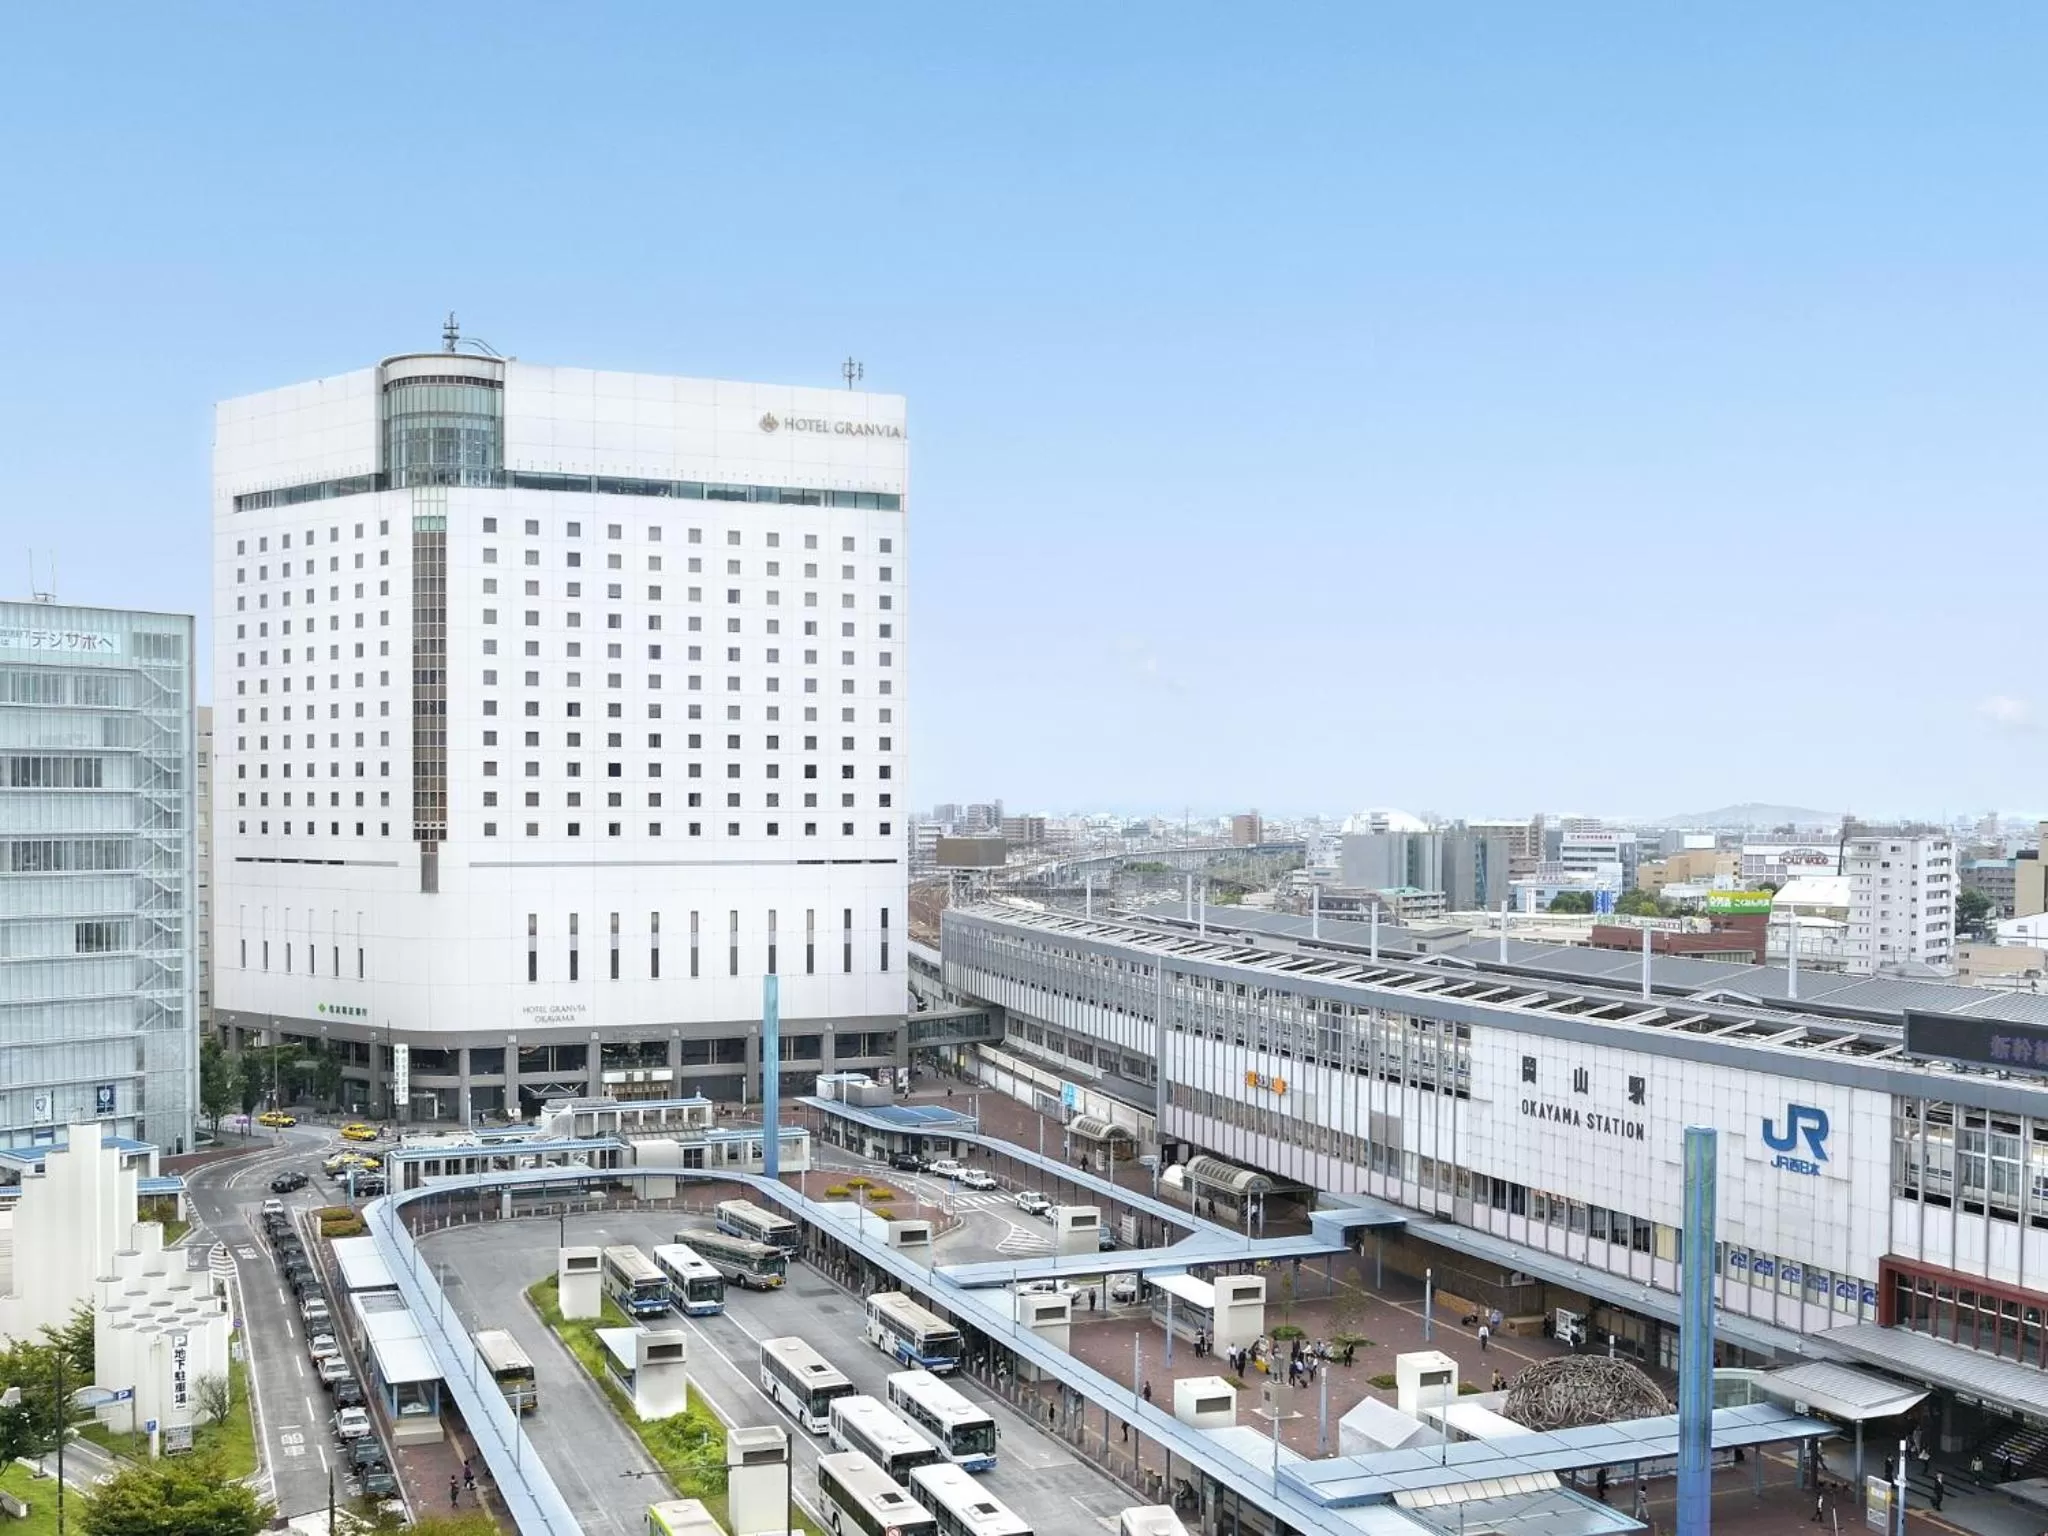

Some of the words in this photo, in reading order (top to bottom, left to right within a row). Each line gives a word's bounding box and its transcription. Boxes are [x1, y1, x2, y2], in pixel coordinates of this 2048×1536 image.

[784, 416, 830, 433] HOTEL
[834, 421, 901, 438] GRANVIA
[522, 1006, 547, 1014] HOTEL
[1521, 1098, 1581, 1128] OKAYAMA
[1587, 1112, 1645, 1141] STATION
[1762, 1103, 1829, 1162] JR
